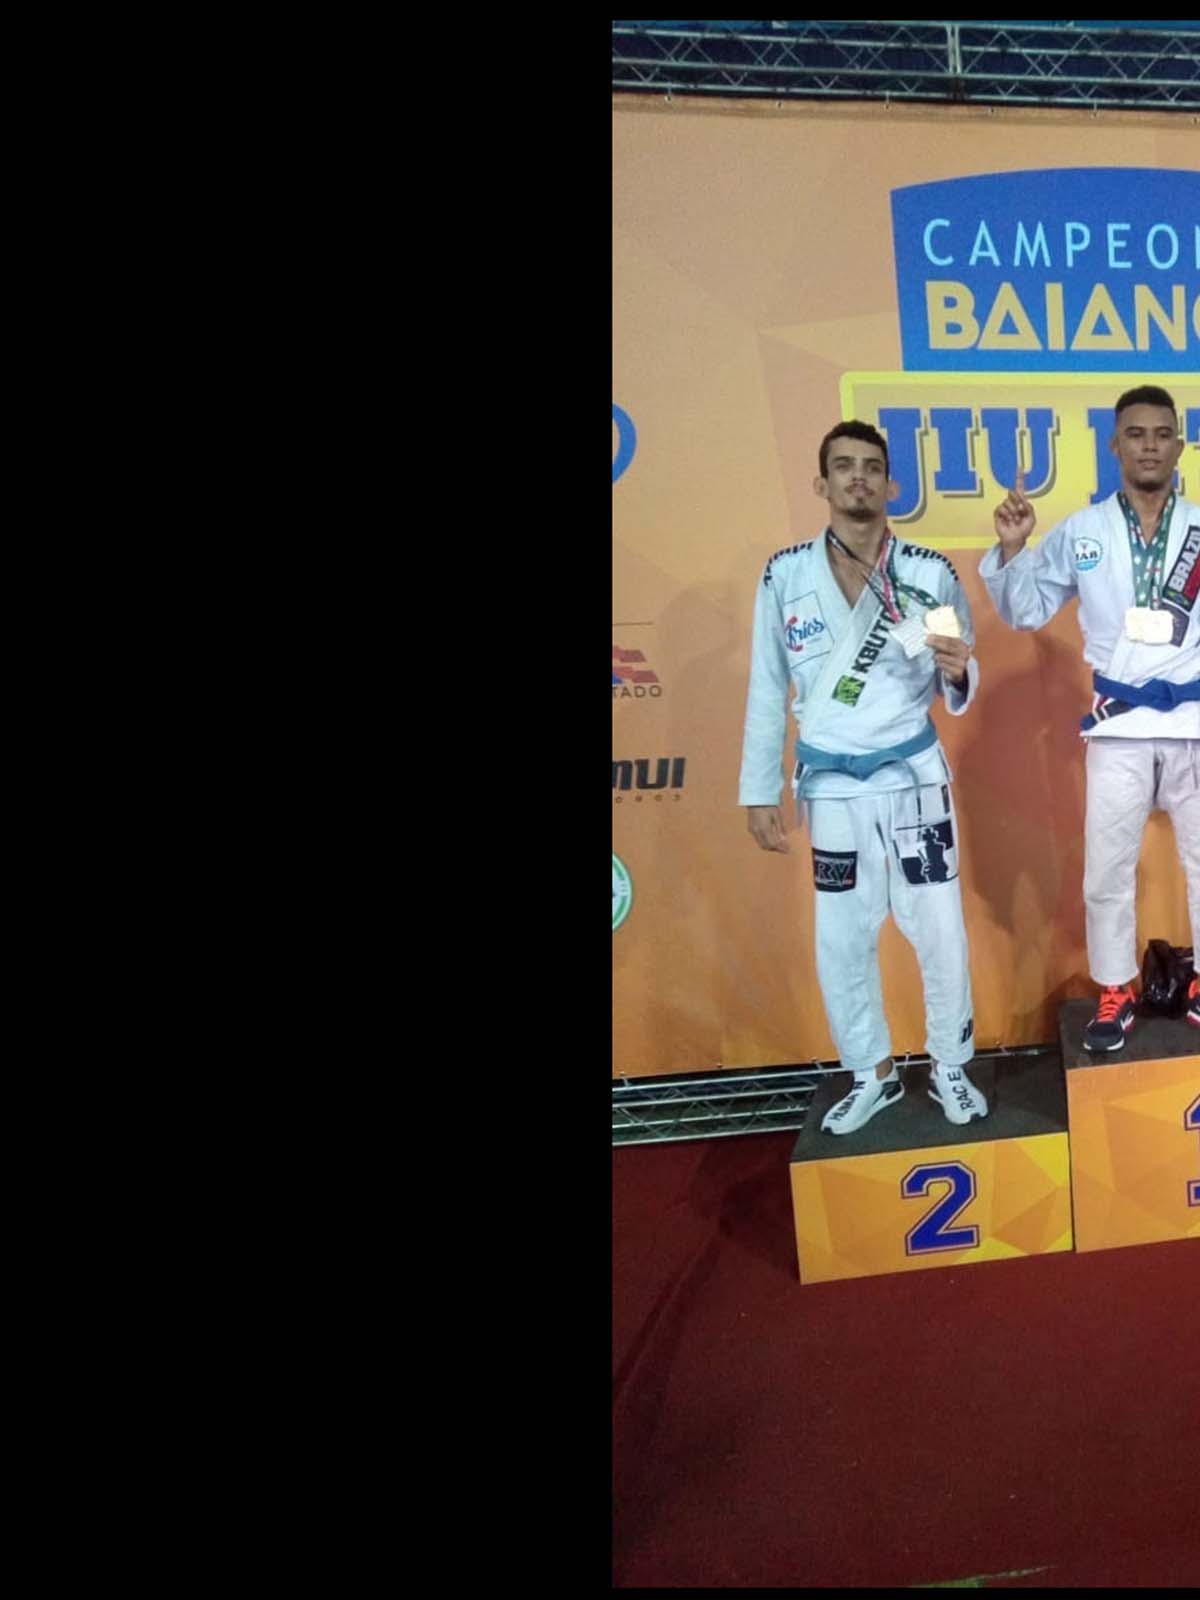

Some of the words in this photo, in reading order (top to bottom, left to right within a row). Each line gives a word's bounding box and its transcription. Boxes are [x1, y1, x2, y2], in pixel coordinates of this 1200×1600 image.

[877, 407, 1055, 520] JIU
[947, 1070, 976, 1111] RACE
[901, 1160, 979, 1256] 2
